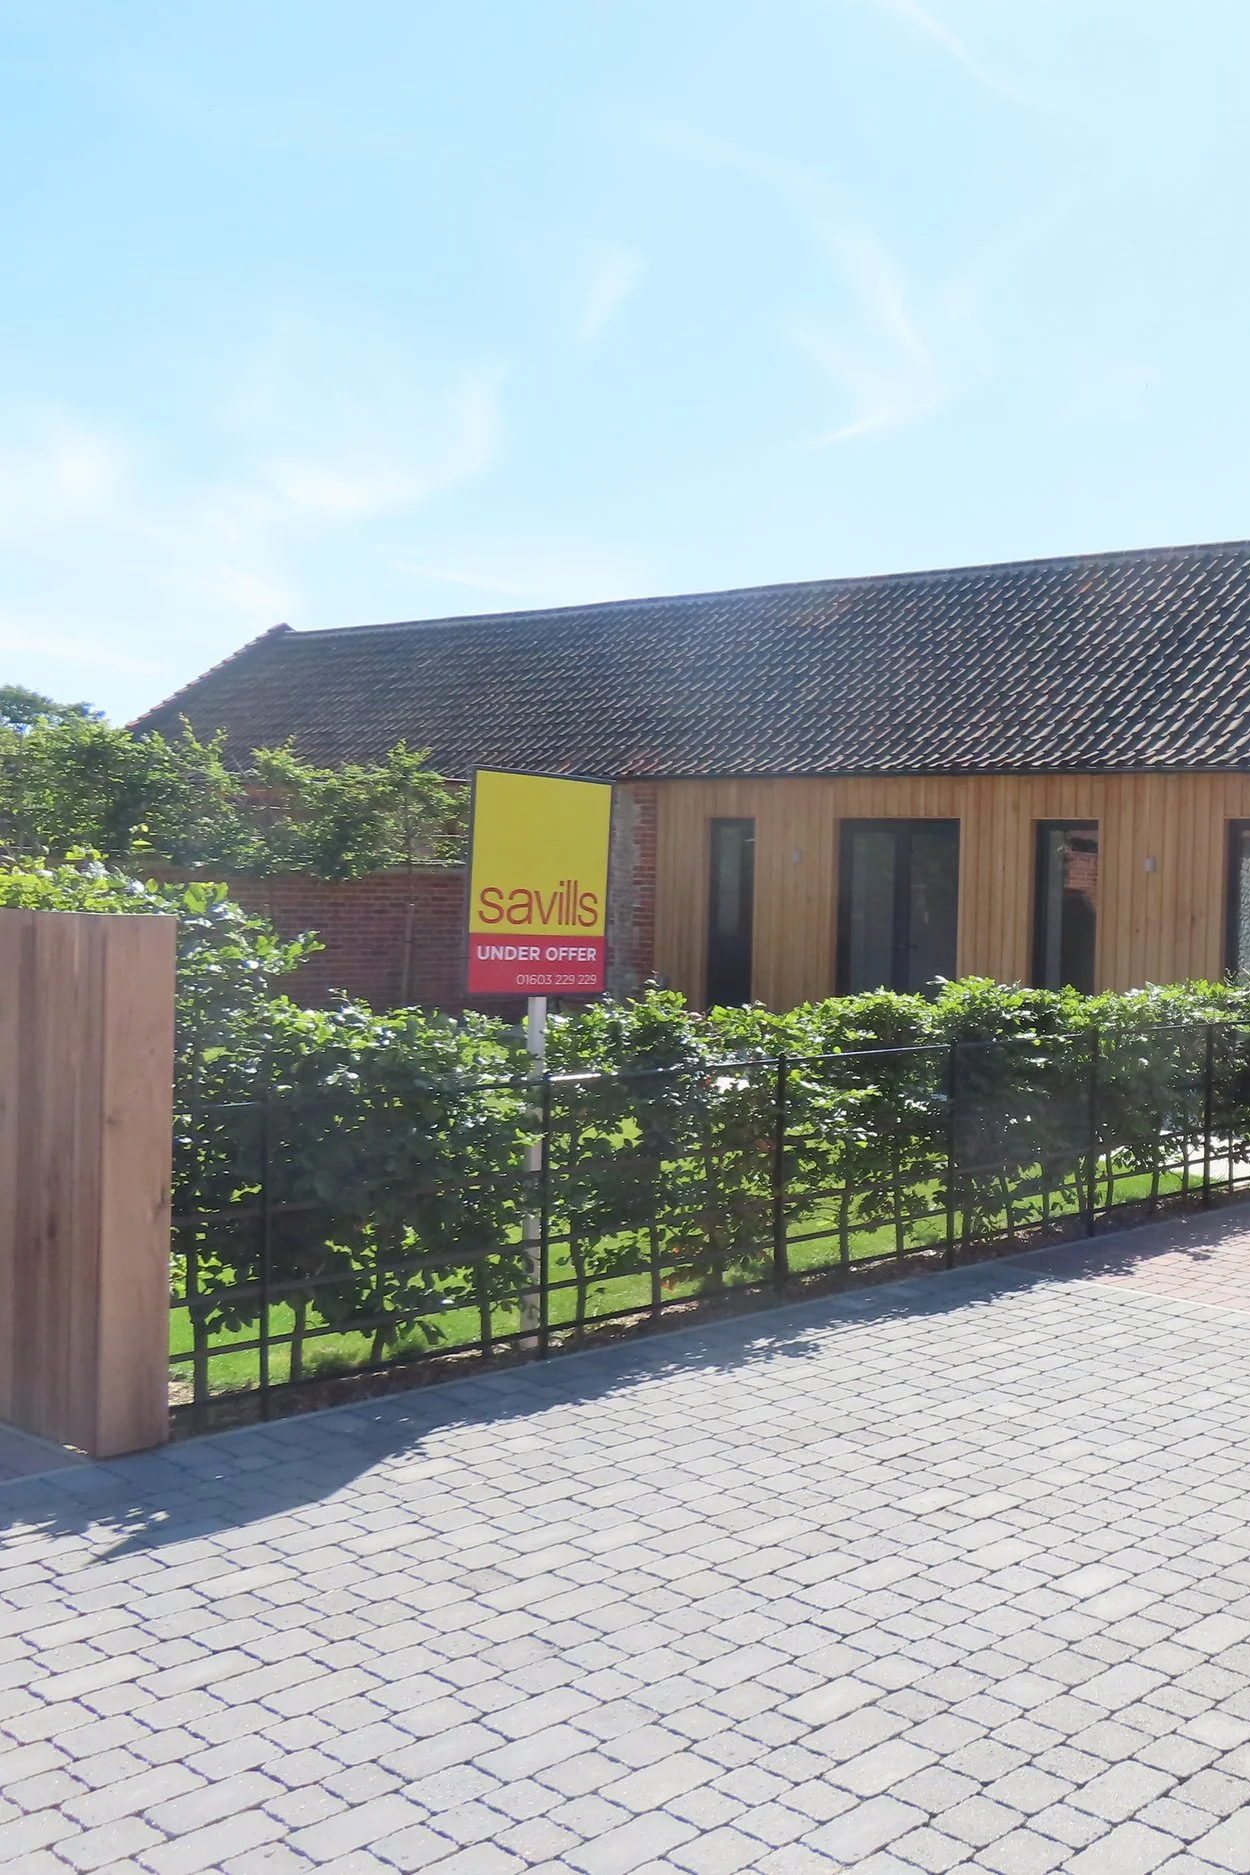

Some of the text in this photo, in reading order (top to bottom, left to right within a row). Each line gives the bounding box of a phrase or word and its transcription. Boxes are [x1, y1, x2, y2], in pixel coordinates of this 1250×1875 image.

[478, 880, 598, 927] savills
[477, 946, 597, 962] UNDER OFFER
[516, 974, 597, 985] 01603 229 229
